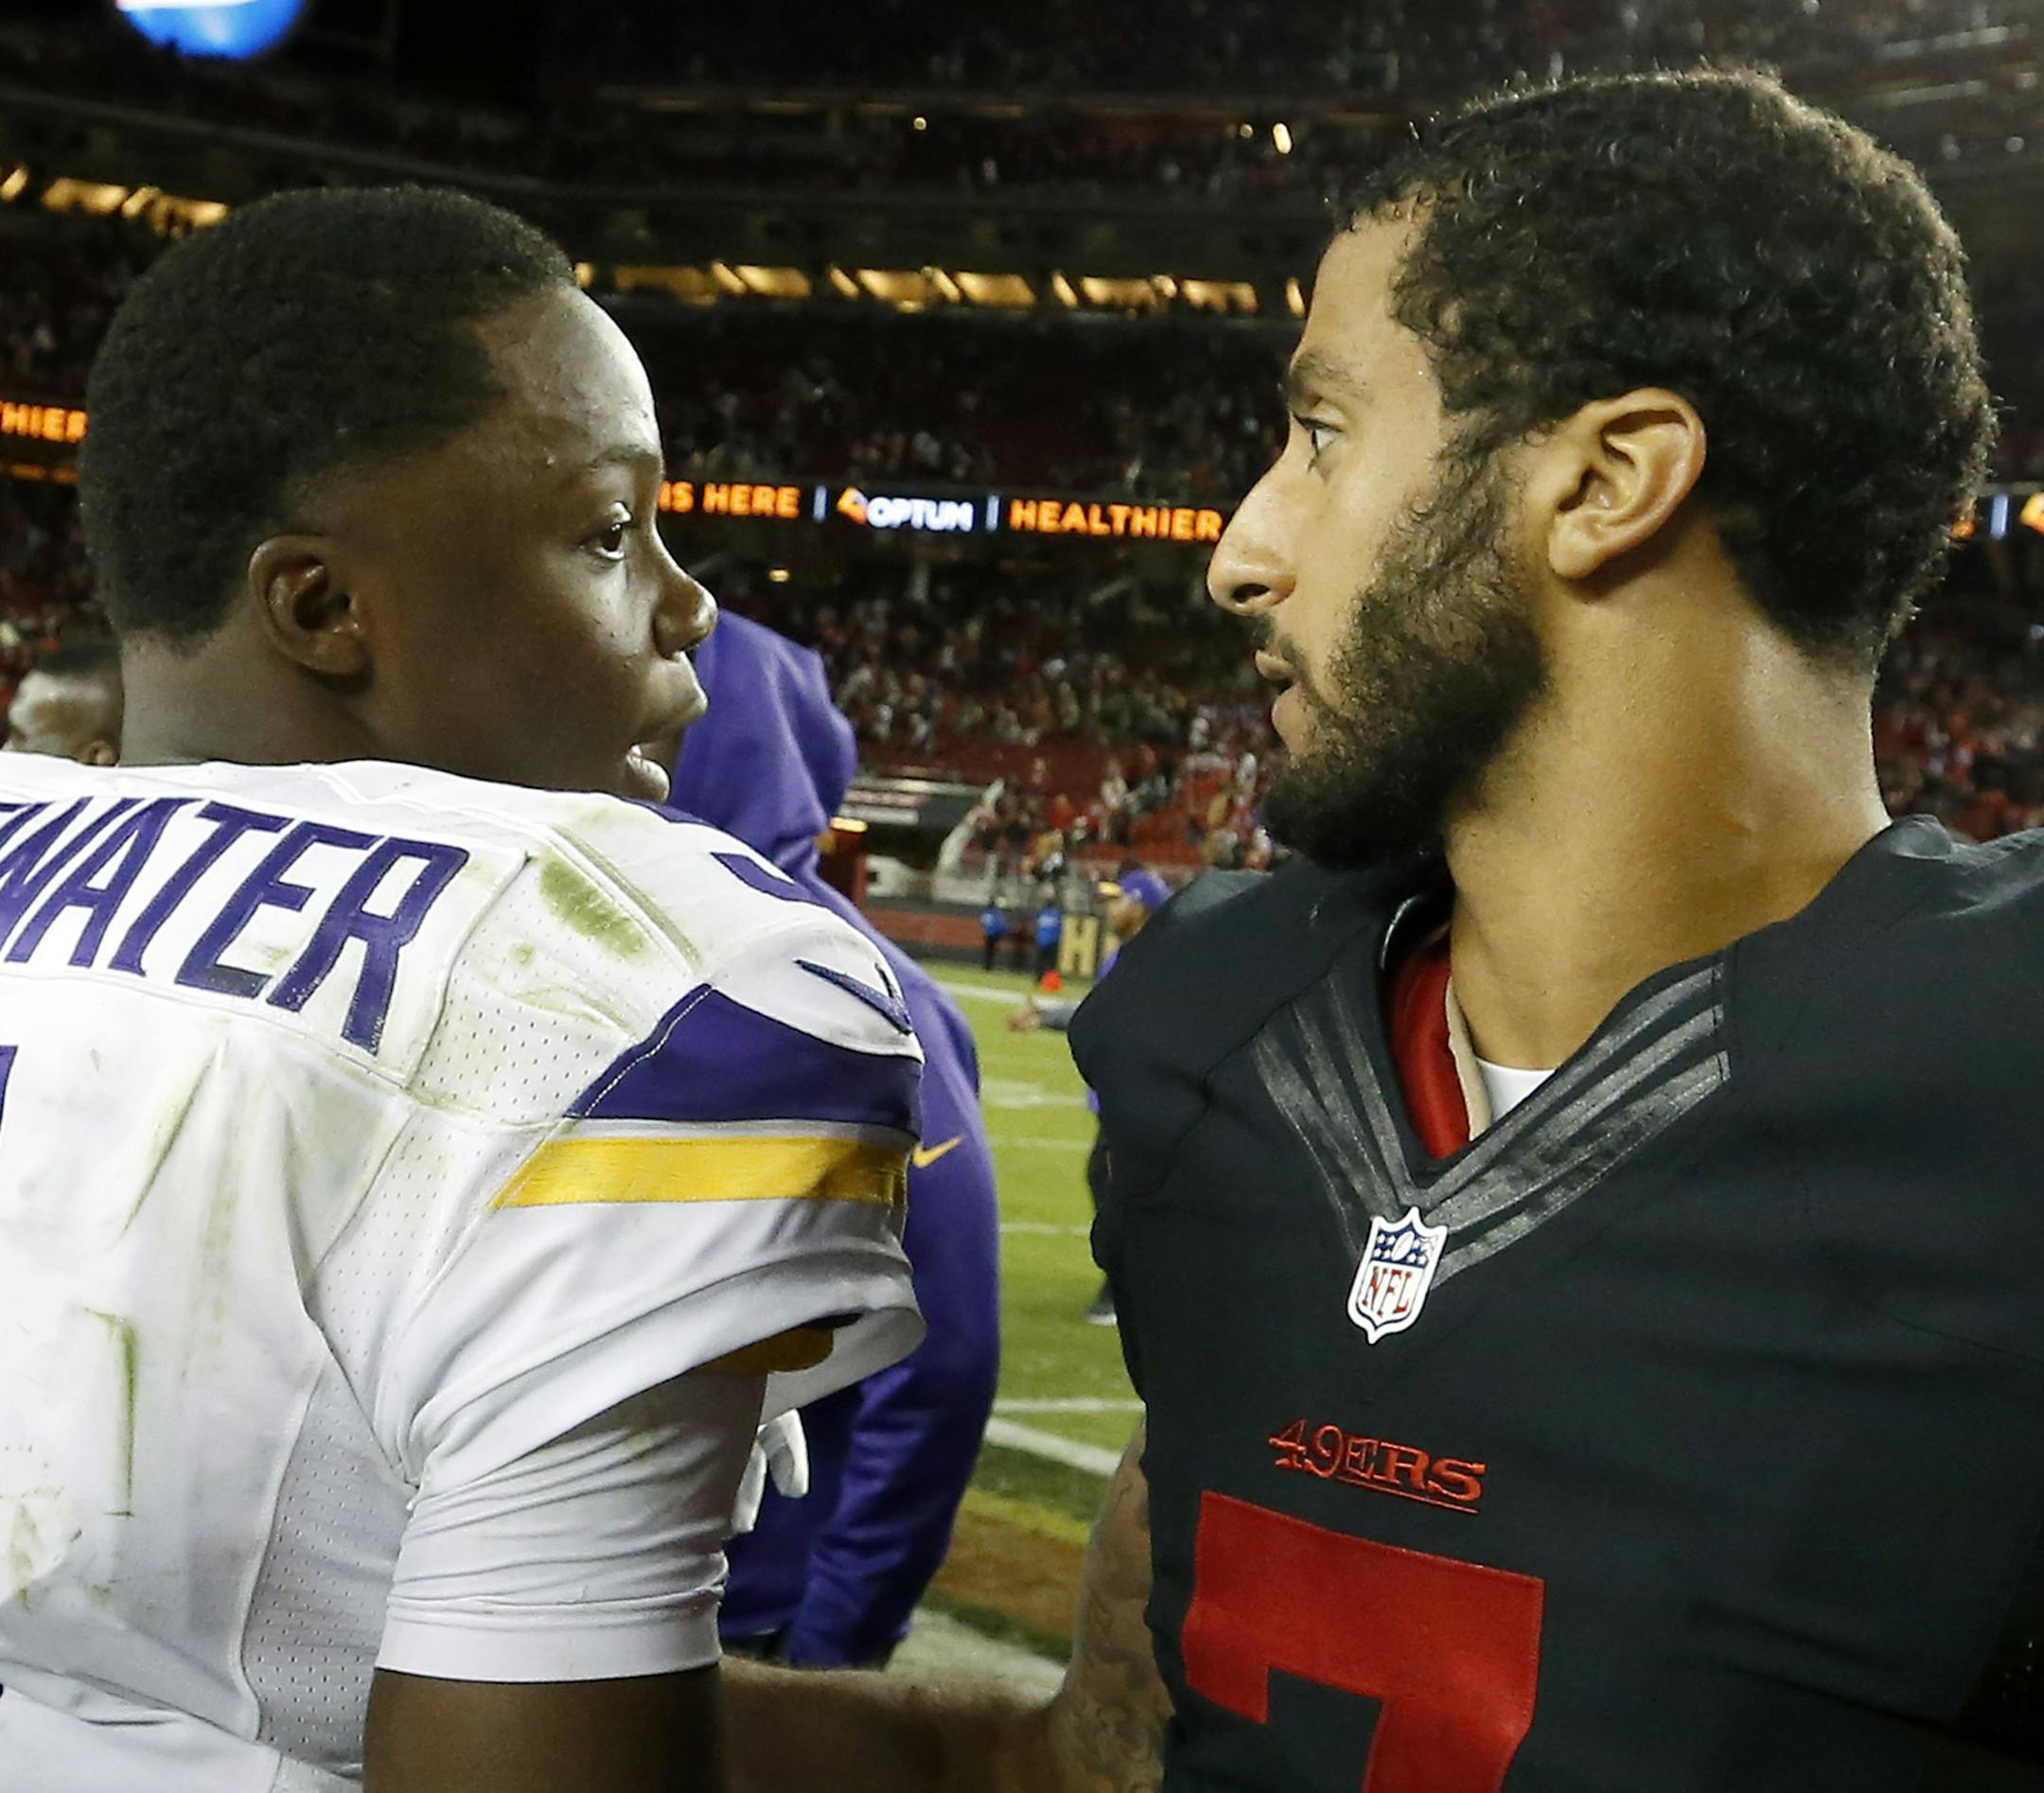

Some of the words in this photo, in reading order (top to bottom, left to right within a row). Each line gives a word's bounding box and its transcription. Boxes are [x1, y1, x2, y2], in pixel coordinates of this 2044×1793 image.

[0, 401, 89, 443] HIER
[659, 481, 694, 513] IS
[703, 483, 801, 519] HERE
[866, 497, 974, 532] OPTUM
[1010, 499, 1223, 542] HEALTHIER
[0, 797, 469, 1057] WATER
[1361, 1266, 1414, 1319] NFL
[1268, 1418, 1488, 1502] 49ERS
[1181, 1490, 1546, 1793] 7
